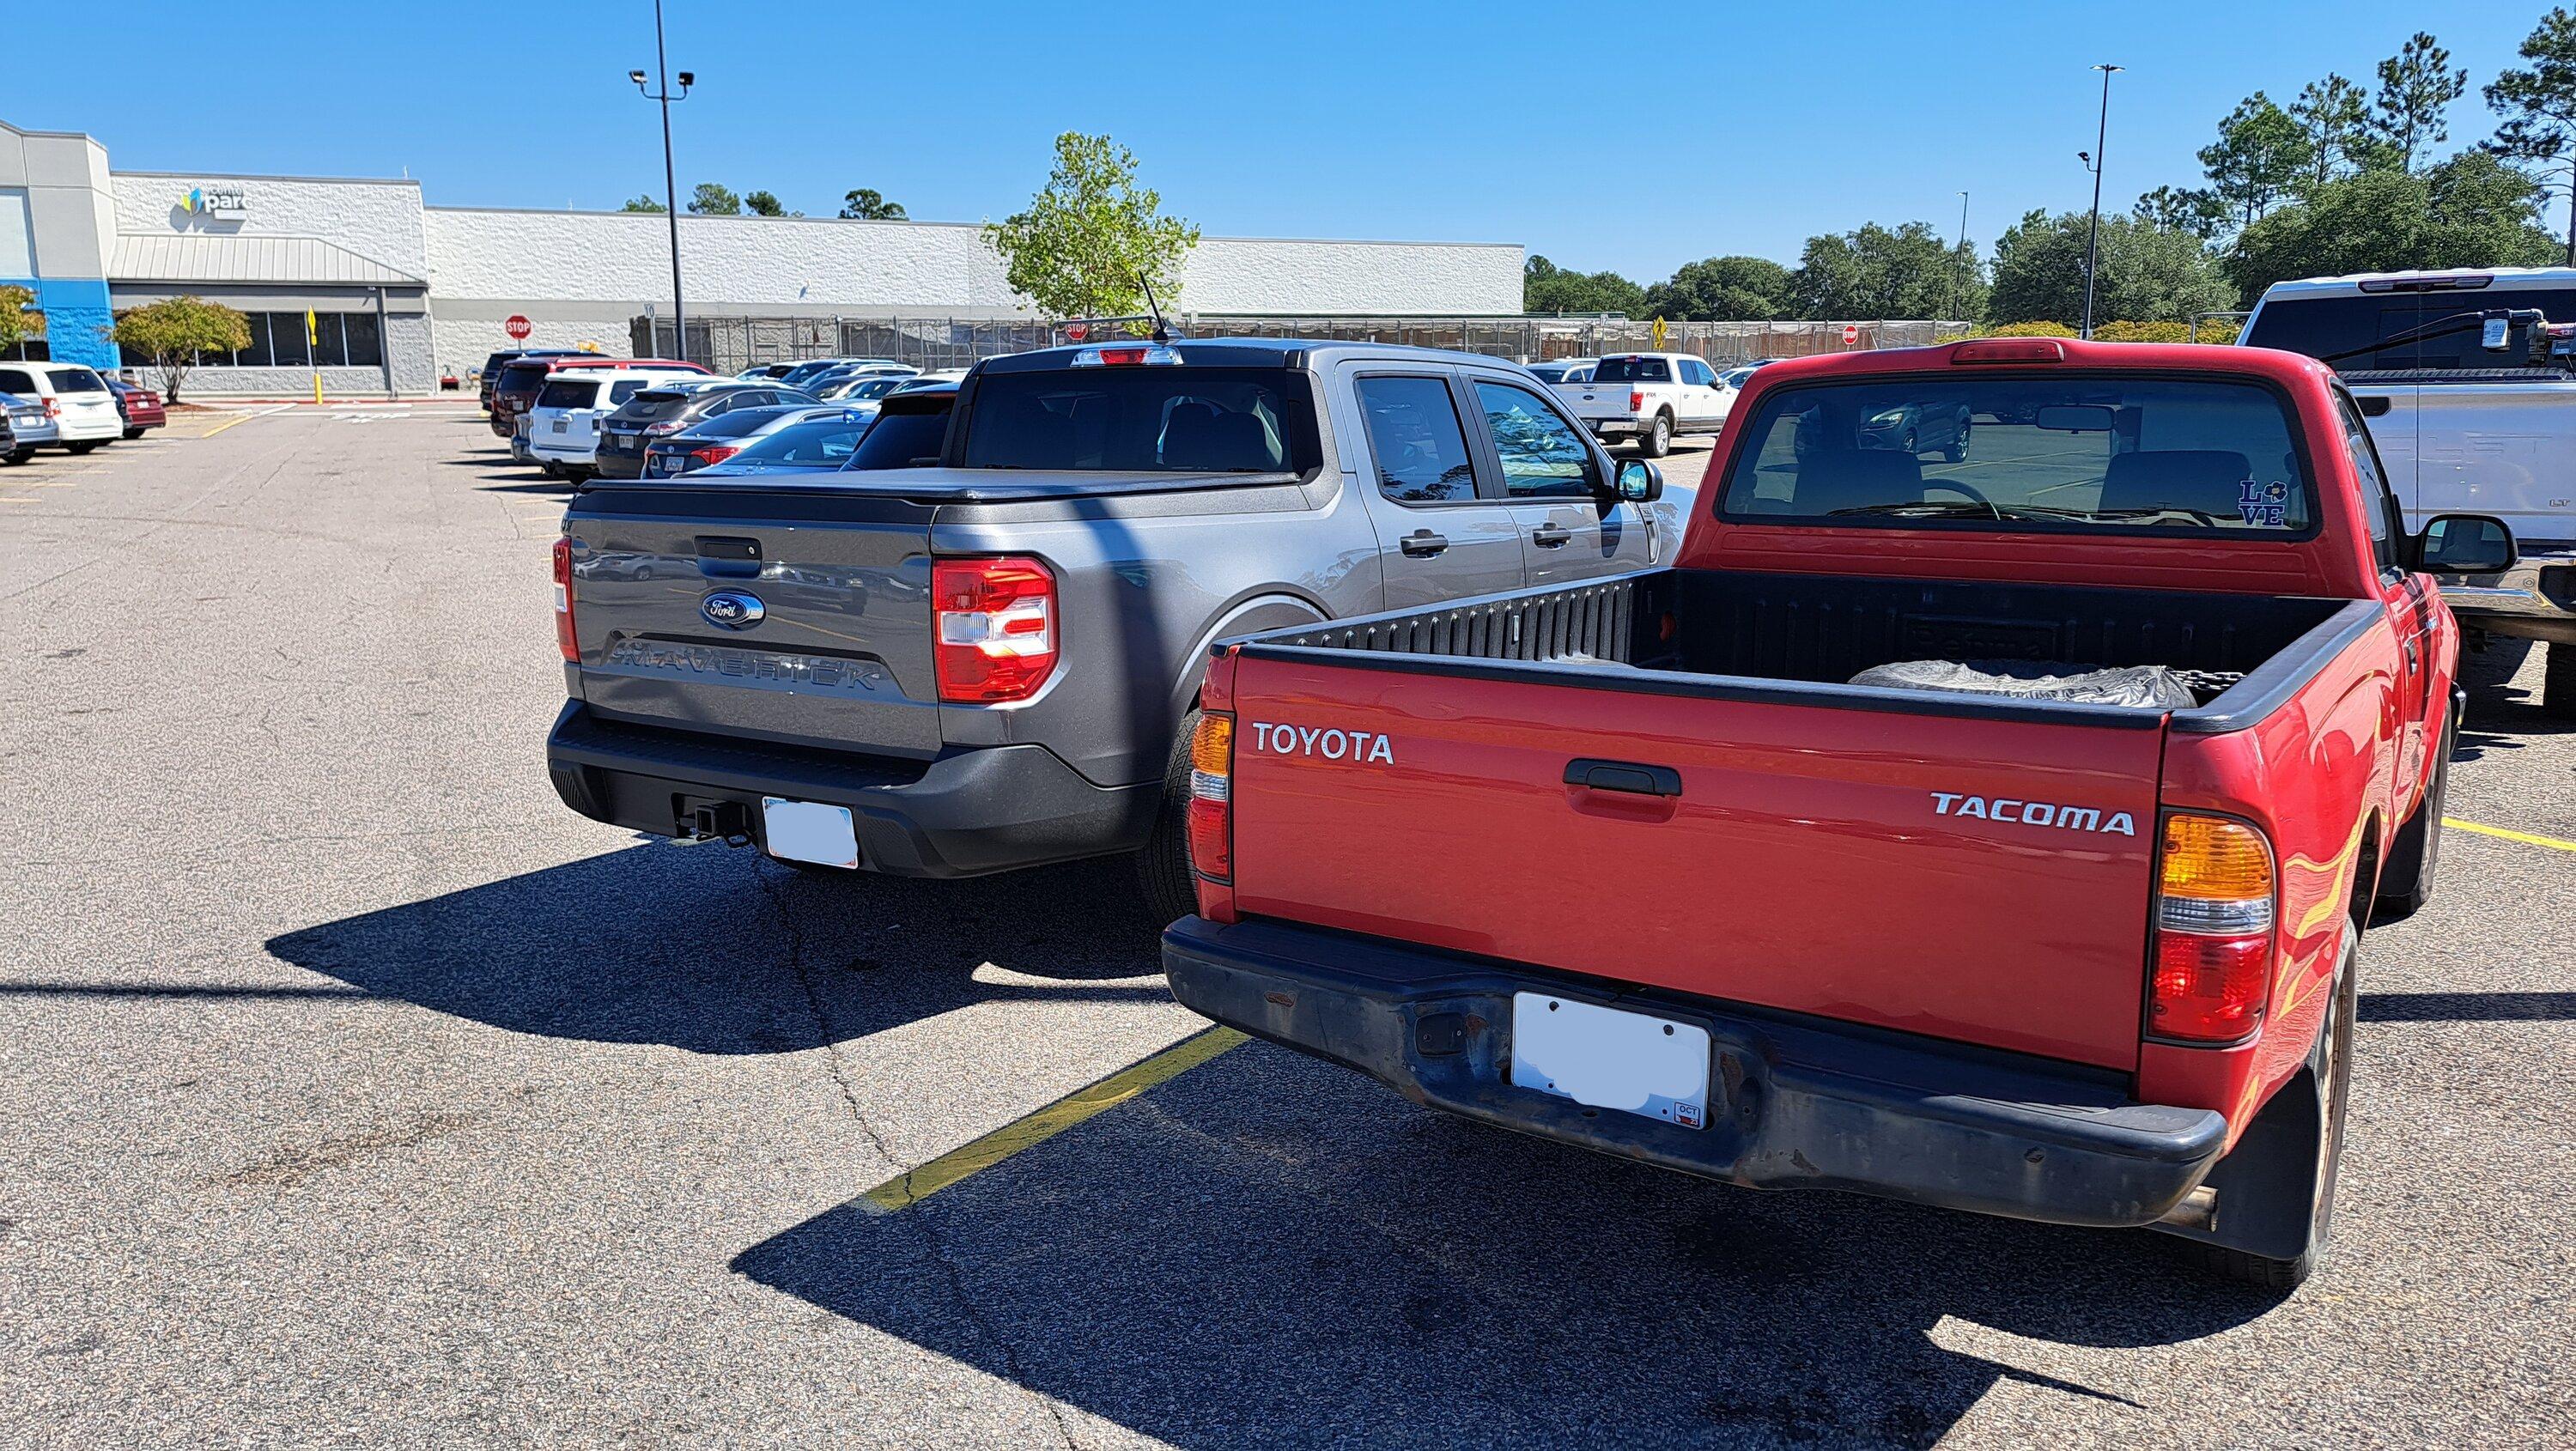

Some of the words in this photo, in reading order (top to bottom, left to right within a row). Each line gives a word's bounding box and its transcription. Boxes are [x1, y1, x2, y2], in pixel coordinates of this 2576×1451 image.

[646, 306, 654, 317] 10
[507, 321, 530, 332] STOP
[1067, 324, 1086, 333] STOP
[710, 600, 737, 616] Ford
[617, 642, 879, 690] MAVERICK
[1252, 722, 1394, 765] TOYOTA
[1930, 792, 2136, 836] TACOMA
[1680, 1105, 1698, 1115] OCT
